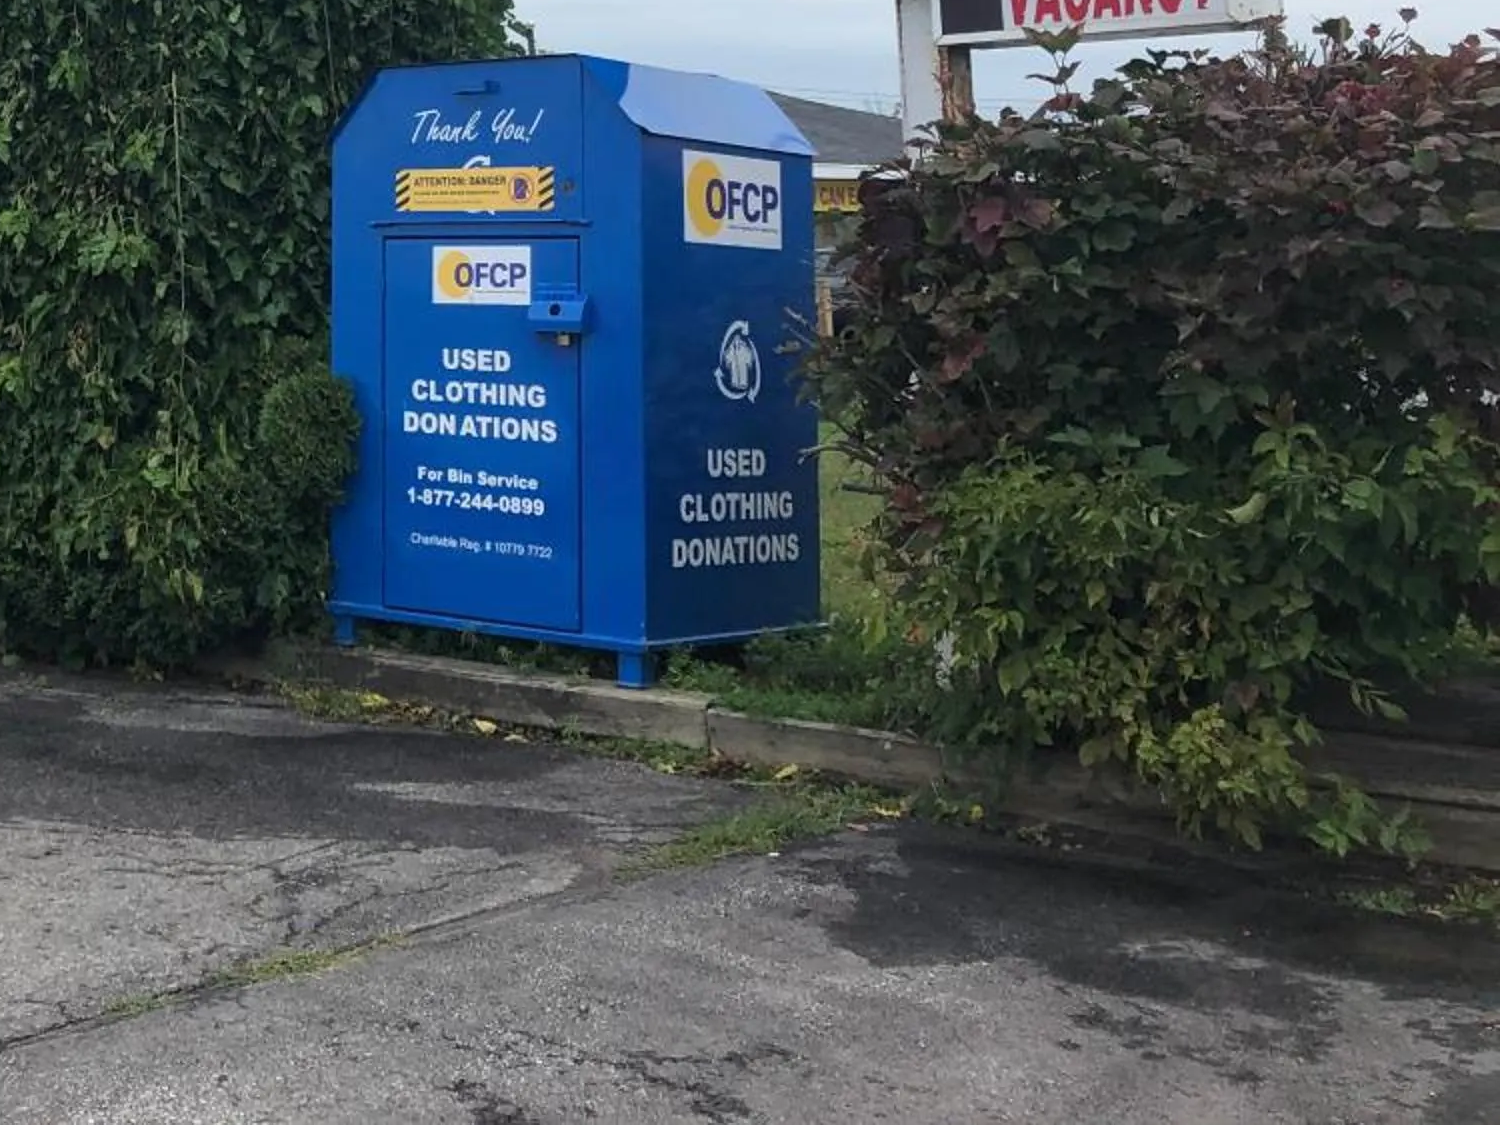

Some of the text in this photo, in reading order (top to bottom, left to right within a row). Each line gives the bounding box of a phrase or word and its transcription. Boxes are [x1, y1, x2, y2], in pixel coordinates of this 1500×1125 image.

[411, 108, 544, 144] Thank You!
[706, 178, 779, 223] OFCP
[454, 262, 527, 288] OFCP
[442, 348, 512, 372] USED
[411, 378, 547, 408] CLOTHING
[403, 410, 557, 443] DONATIONS
[417, 466, 539, 490] For Bin Service
[707, 448, 766, 478] USED
[407, 486, 545, 516] 1-877-244-0899
[680, 491, 793, 523] CLOTHING
[672, 533, 799, 567] DONATIONS
